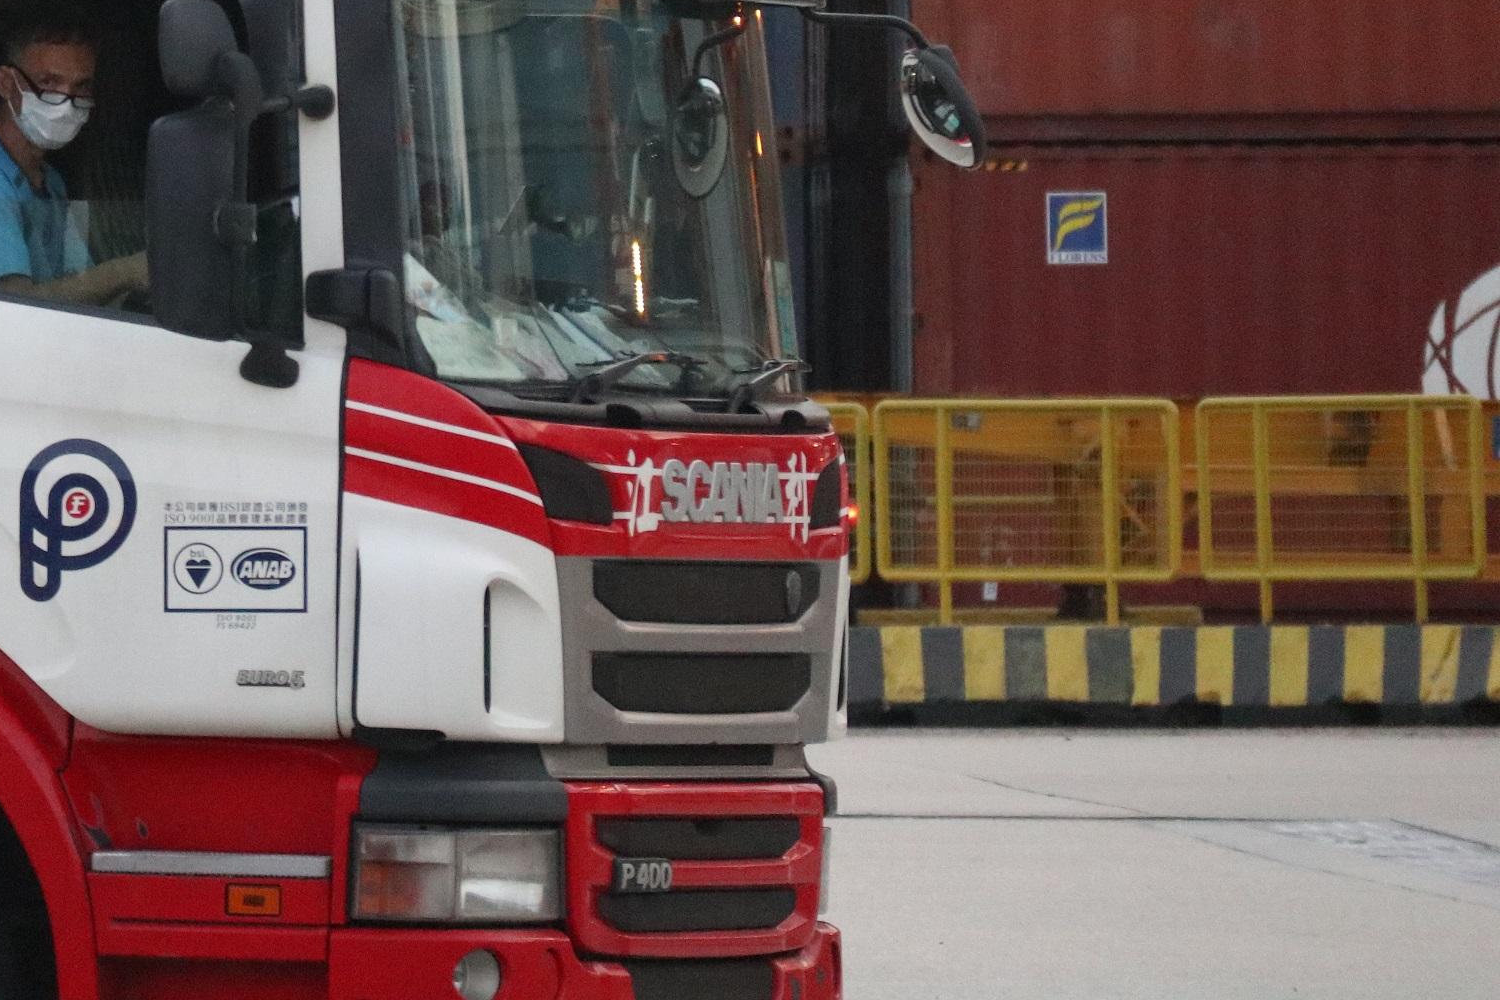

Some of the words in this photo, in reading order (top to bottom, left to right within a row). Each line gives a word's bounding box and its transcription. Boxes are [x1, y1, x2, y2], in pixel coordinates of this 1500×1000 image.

[661, 459, 784, 524] SCANIA
[240, 560, 294, 579] ANAB
[236, 669, 290, 687] EURO
